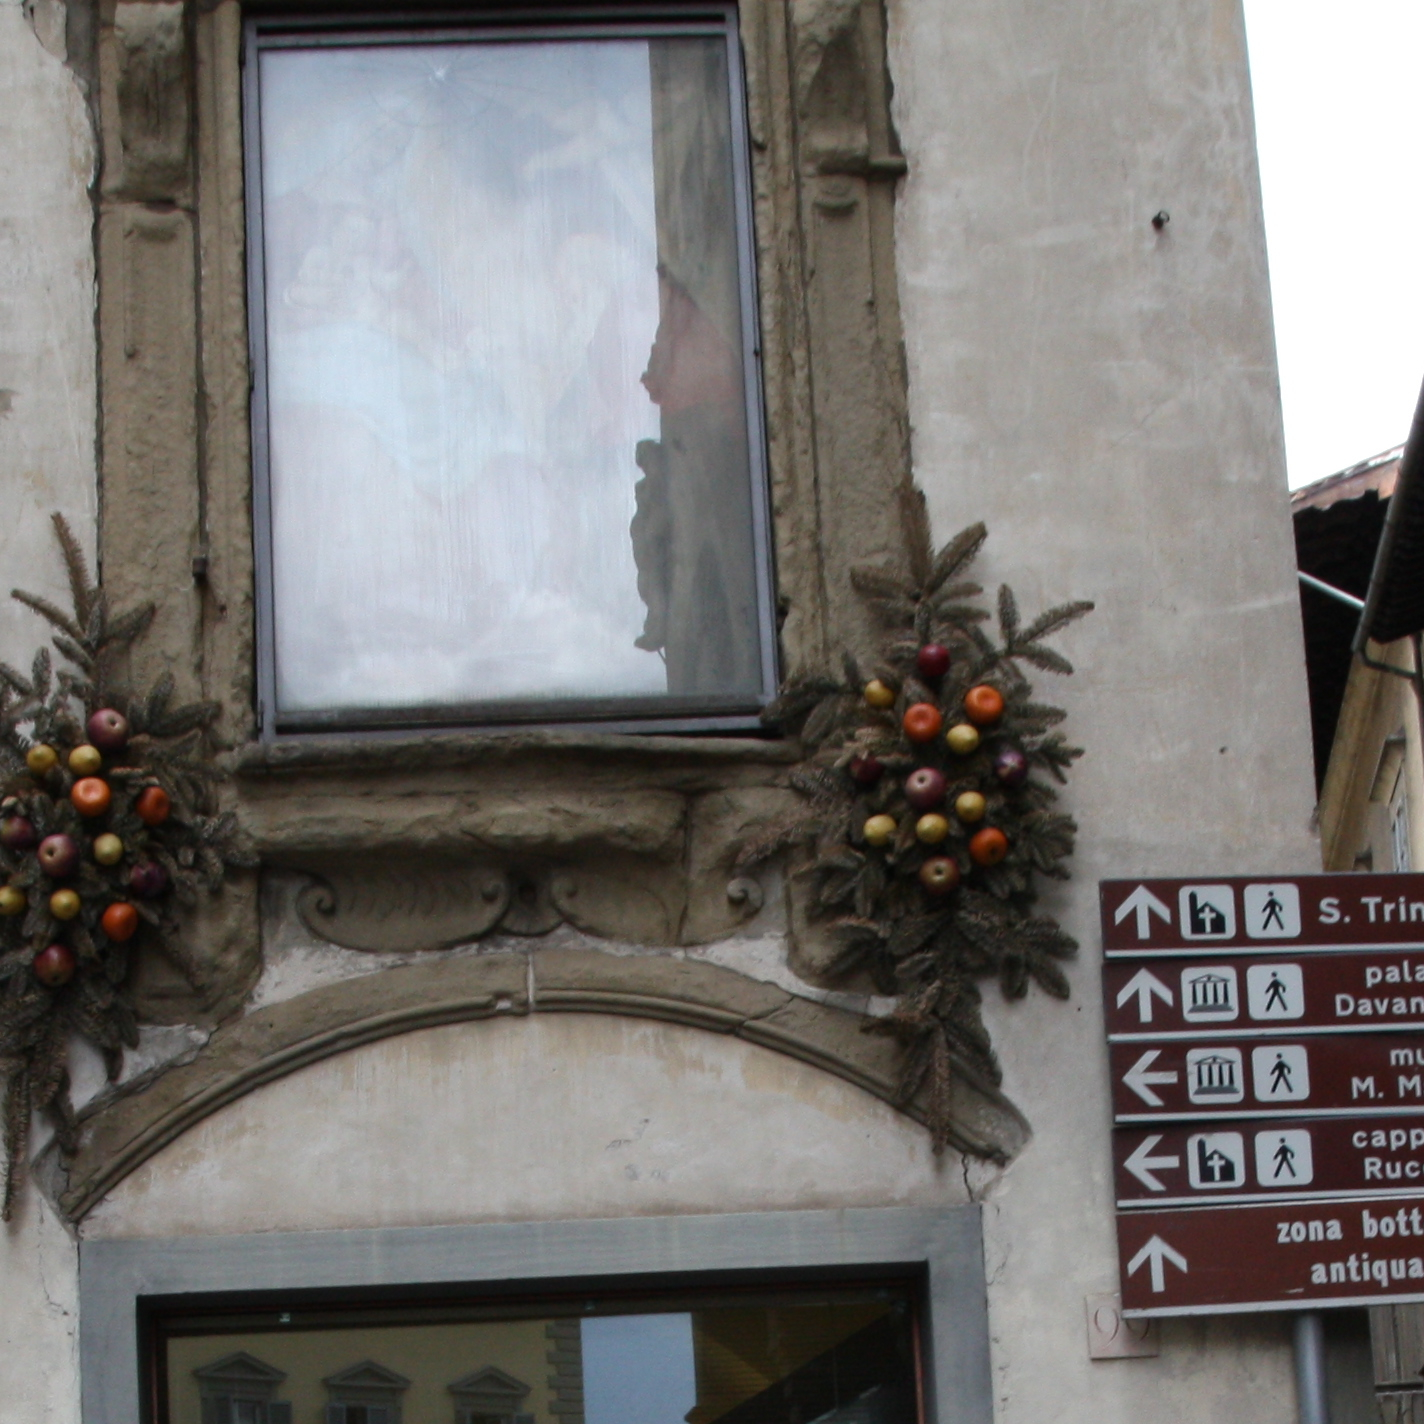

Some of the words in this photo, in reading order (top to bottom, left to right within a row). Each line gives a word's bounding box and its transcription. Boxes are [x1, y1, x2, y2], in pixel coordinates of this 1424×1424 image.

[1318, 897, 1351, 925] S.
[1351, 1076, 1384, 1100] M.
[1277, 1216, 1343, 1244] zona
